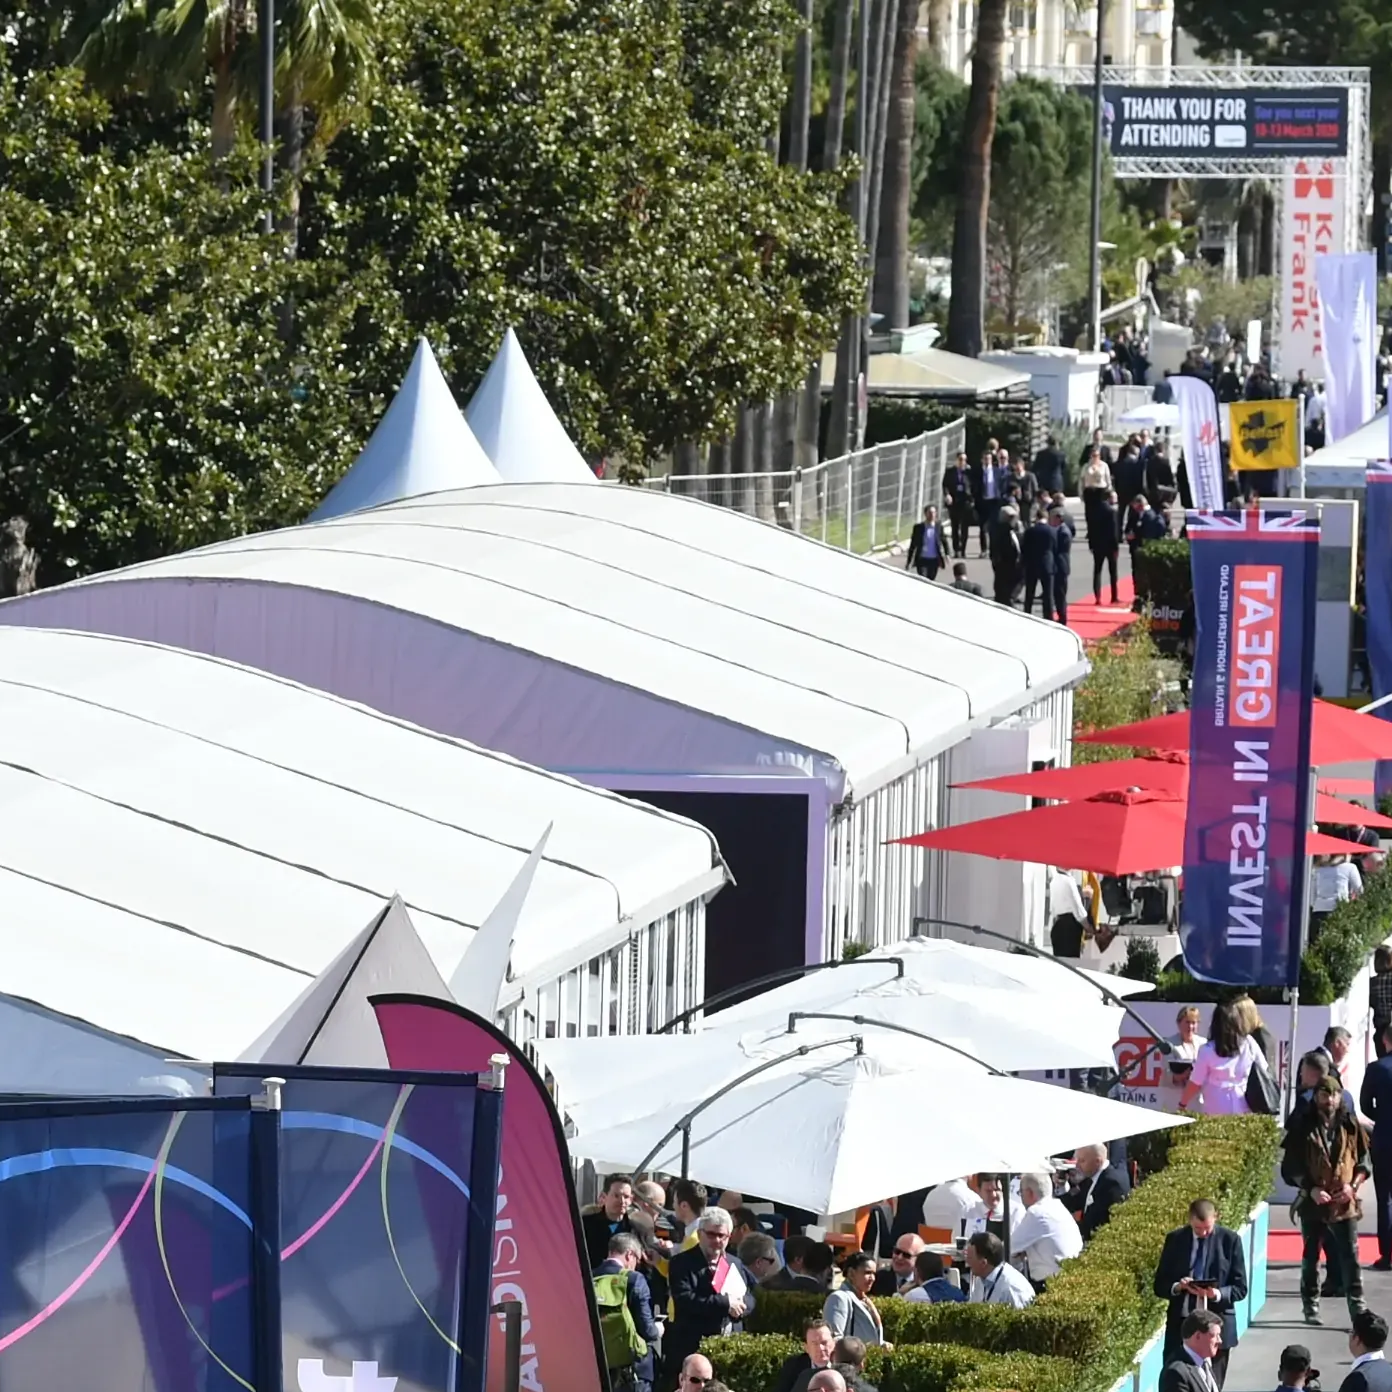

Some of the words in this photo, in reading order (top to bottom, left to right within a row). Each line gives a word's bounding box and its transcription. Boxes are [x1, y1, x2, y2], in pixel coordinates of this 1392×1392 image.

[1121, 97, 1177, 120] THANK
[1179, 97, 1210, 120] YOU
[1214, 98, 1246, 120] FOR
[1120, 124, 1210, 147] ATTENDING
[1292, 213, 1310, 332] Frank
[1150, 1094, 1157, 1104] &
